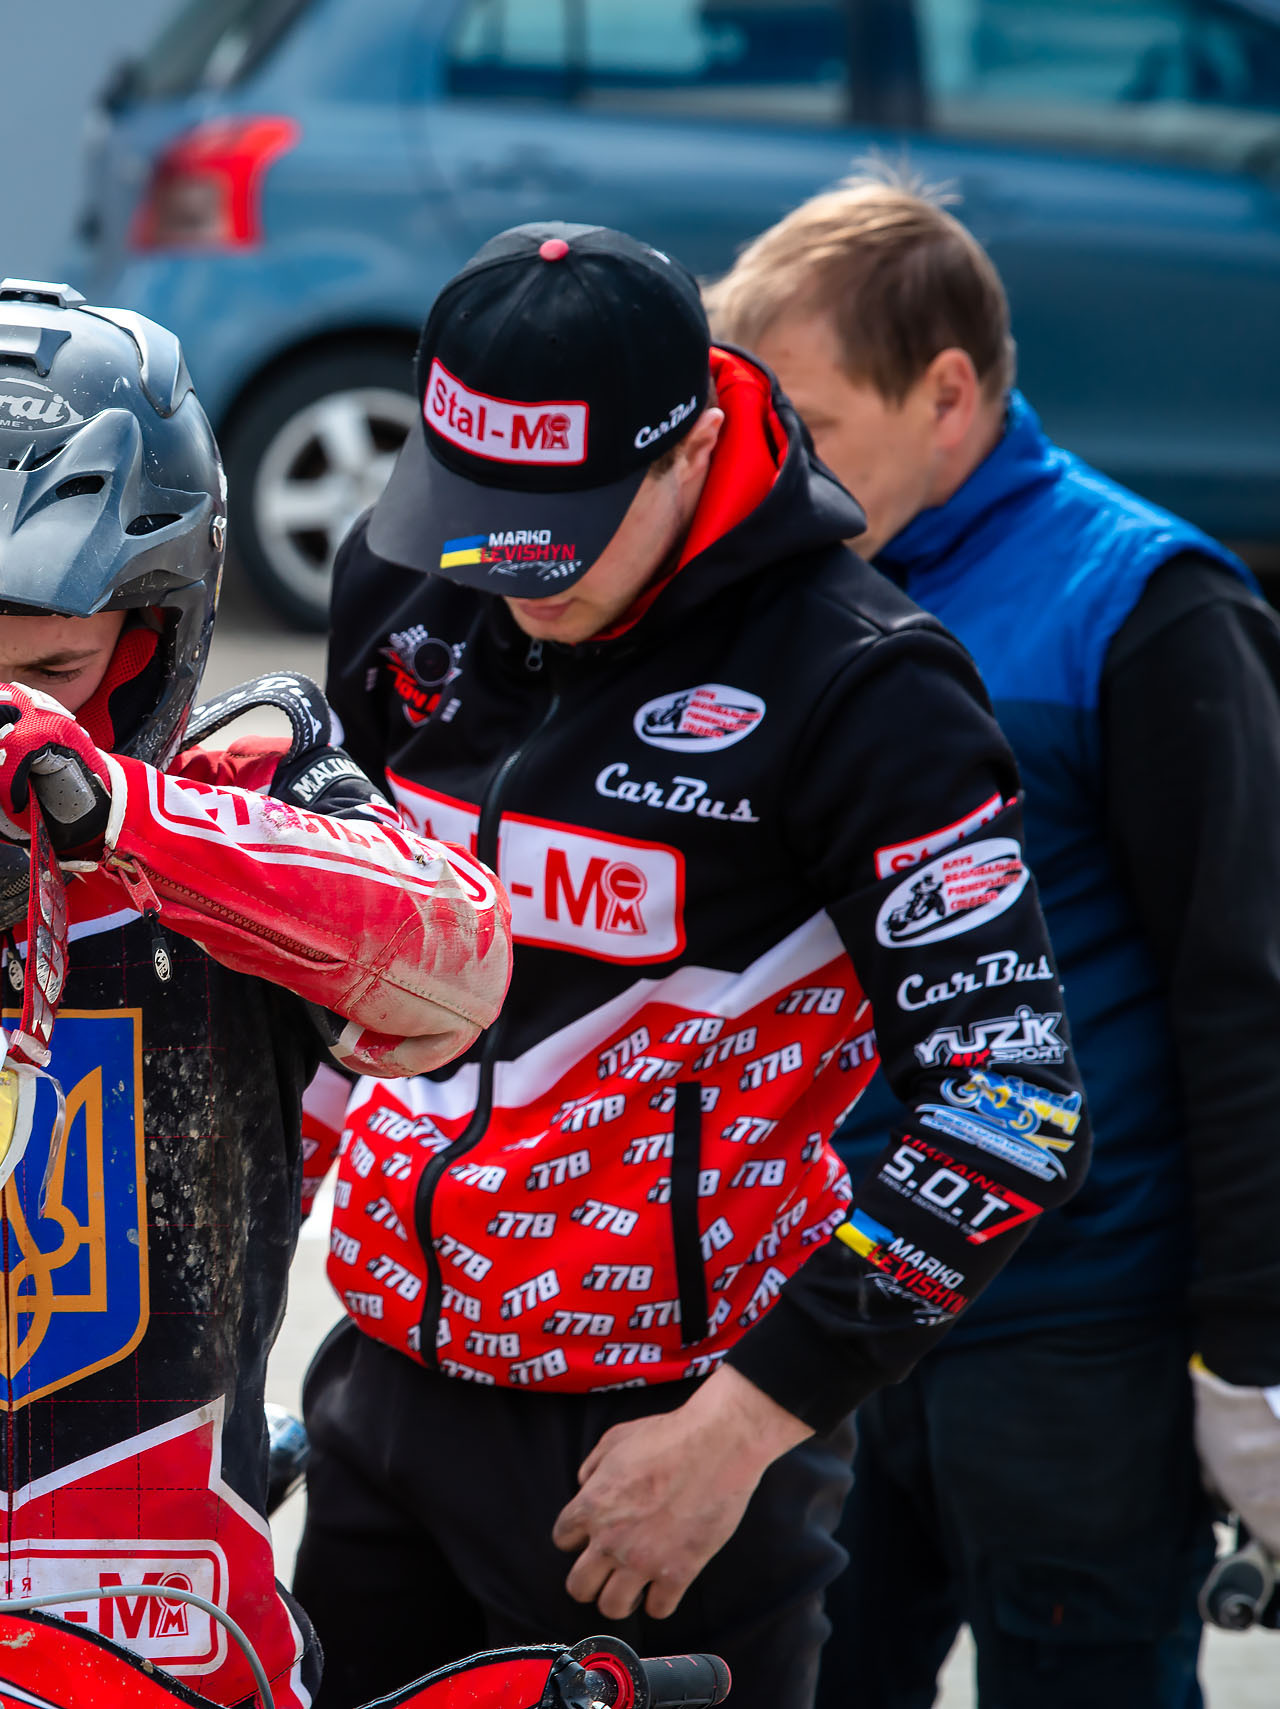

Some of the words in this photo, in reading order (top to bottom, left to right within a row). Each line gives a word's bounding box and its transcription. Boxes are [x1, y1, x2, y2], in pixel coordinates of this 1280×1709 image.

[480, 544, 576, 563] LEVISHYN
[488, 530, 551, 546] MARKO
[595, 763, 759, 823] CarBus
[897, 950, 1054, 1011] CarBus
[991, 1046, 1063, 1061] SPORT
[866, 1244, 969, 1315] LEVISHYN
[888, 1237, 965, 1290] MARKO
